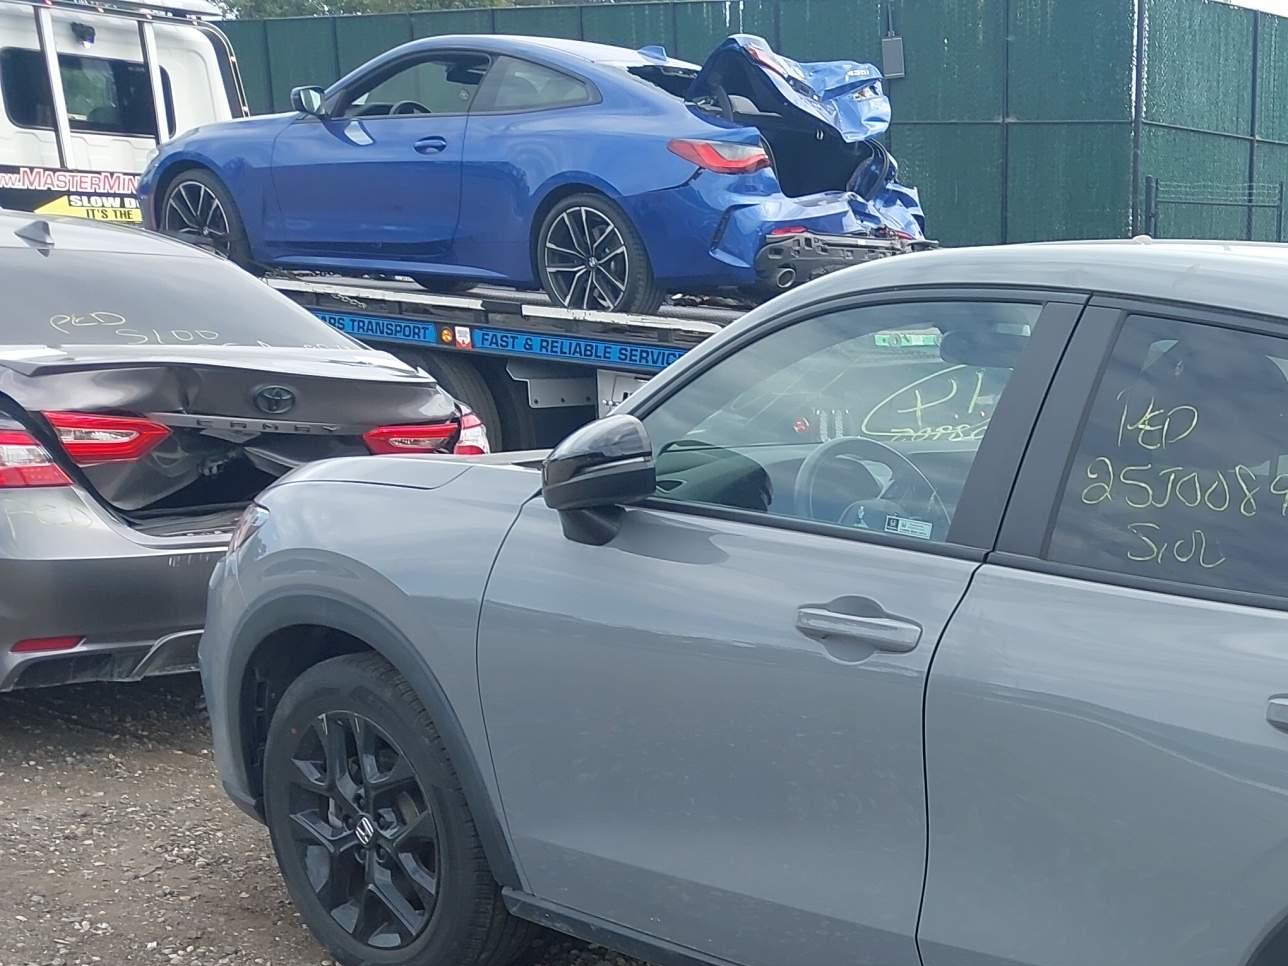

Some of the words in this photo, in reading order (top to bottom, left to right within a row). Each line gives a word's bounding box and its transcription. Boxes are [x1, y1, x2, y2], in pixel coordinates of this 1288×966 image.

[69, 195, 121, 208] SLOW
[86, 208, 109, 219] IT'S
[113, 209, 134, 220] THE
[350, 316, 430, 340] TRANSPORT
[480, 332, 518, 350] FAST
[523, 337, 534, 351] &
[540, 339, 612, 360] RELIABLE
[617, 348, 686, 367] SERVIC
